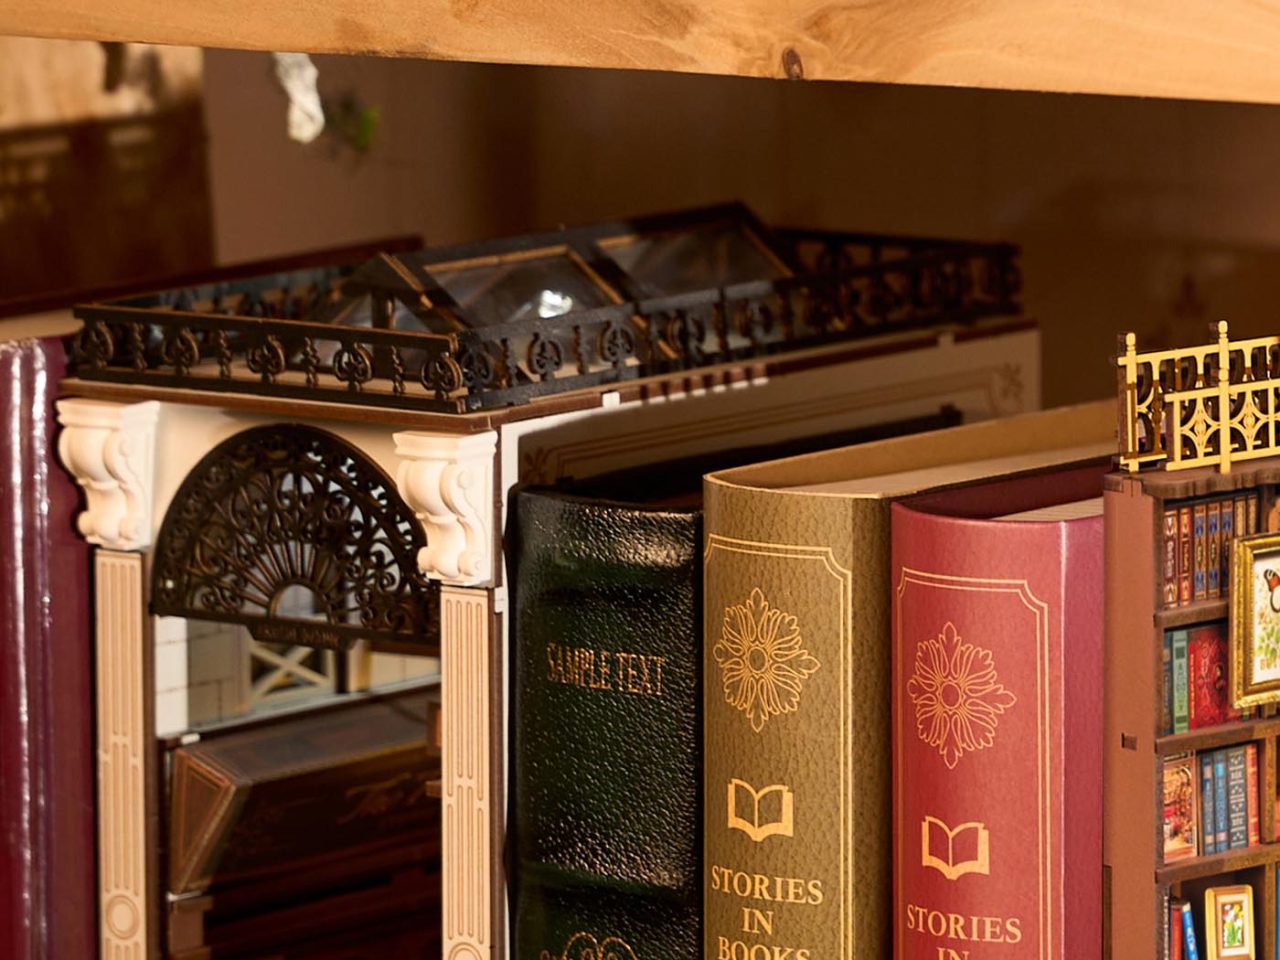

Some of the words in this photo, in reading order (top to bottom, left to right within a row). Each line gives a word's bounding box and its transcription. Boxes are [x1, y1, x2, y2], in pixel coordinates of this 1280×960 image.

[546, 642, 611, 689] SAMPLE
[615, 652, 666, 696] TEXT
[711, 866, 825, 905] STORIES
[742, 908, 774, 936] IN
[907, 904, 1022, 944] STORIES
